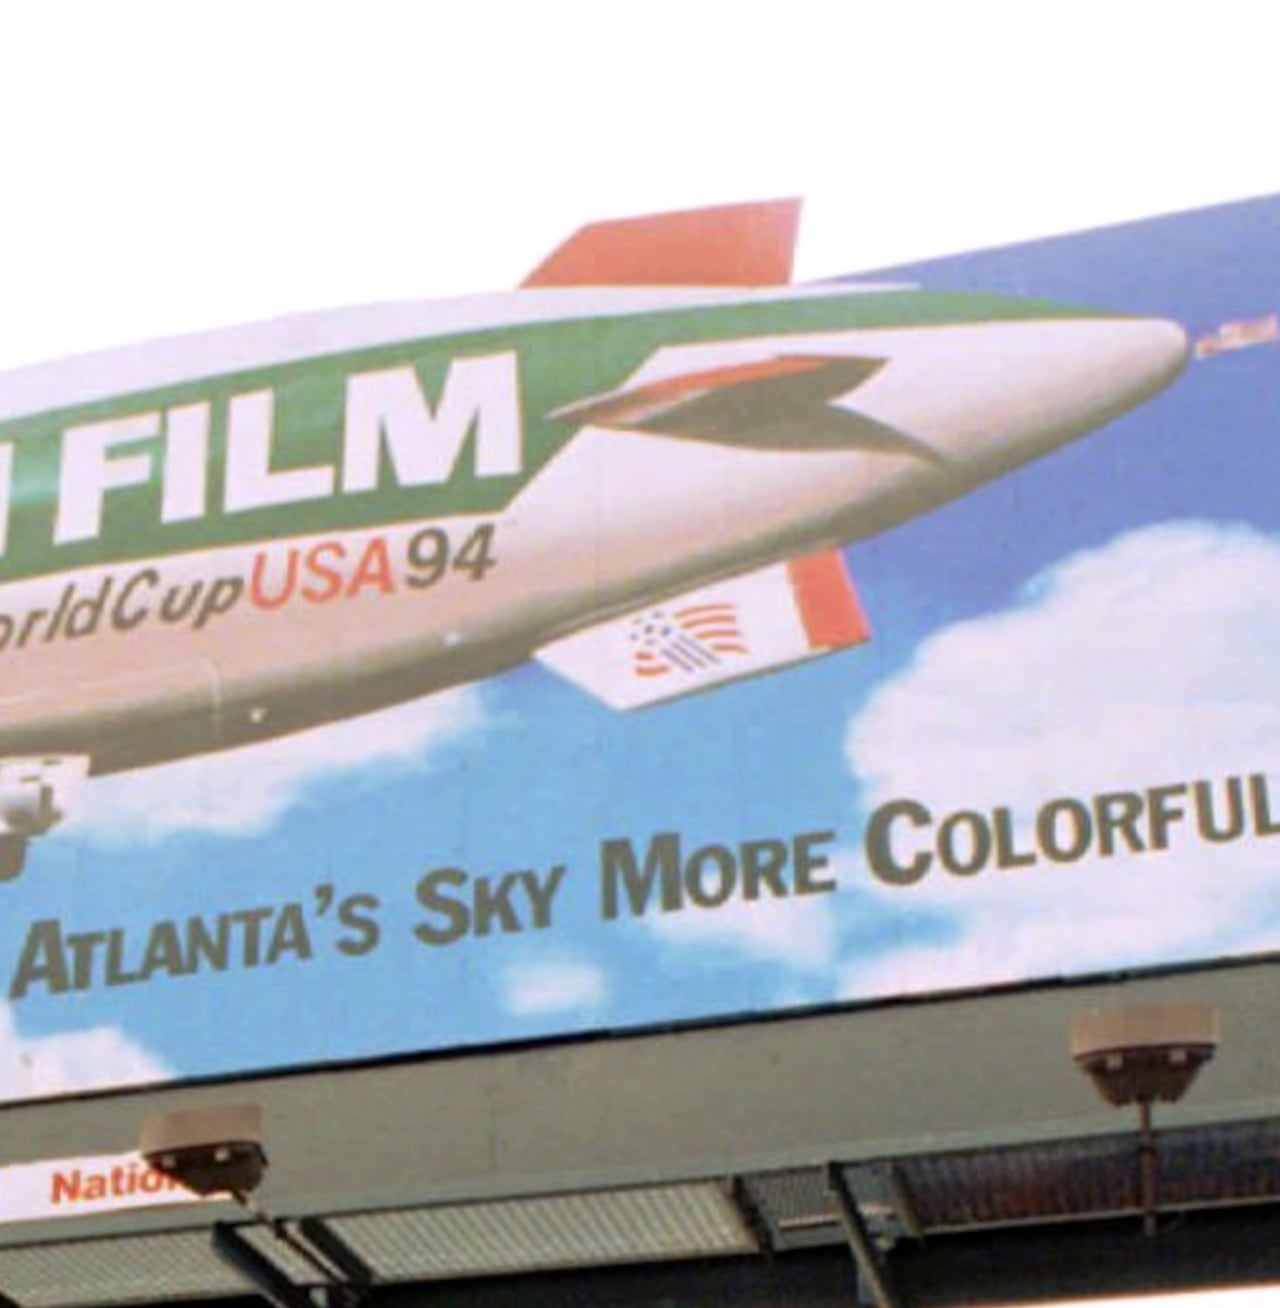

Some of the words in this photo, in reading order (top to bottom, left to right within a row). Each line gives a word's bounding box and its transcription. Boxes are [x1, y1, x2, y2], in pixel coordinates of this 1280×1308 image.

[53, 350, 522, 545] FILM
[10, 884, 380, 1000] ATLANTA'S
[412, 863, 568, 948] SKY
[600, 829, 837, 921] MORE
